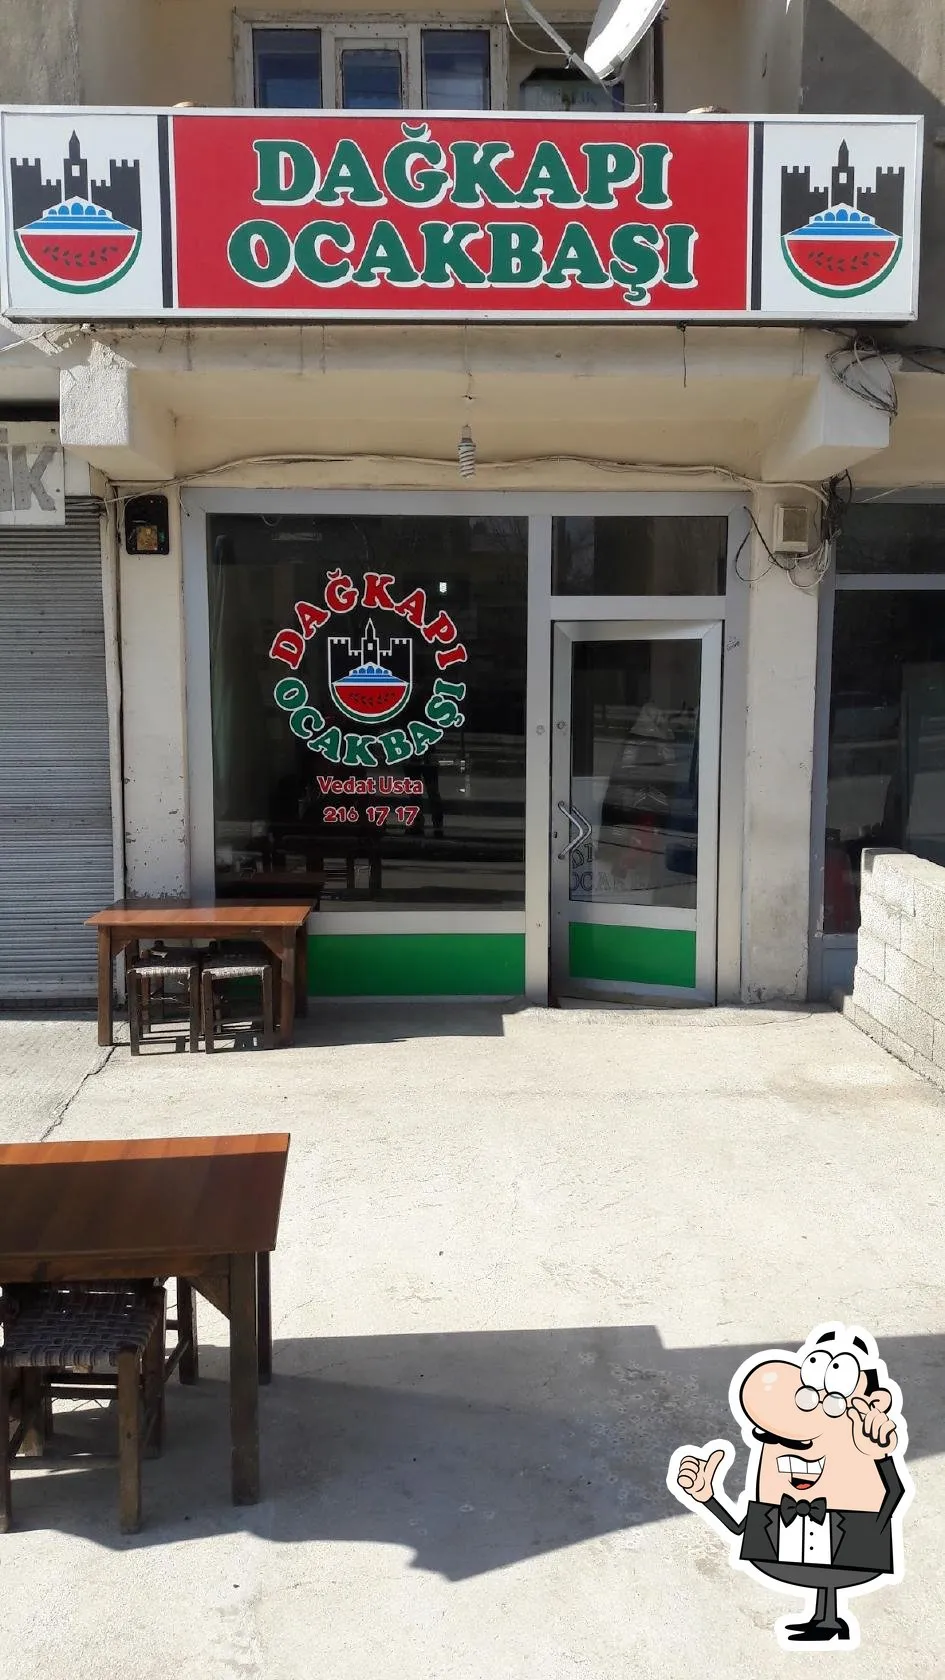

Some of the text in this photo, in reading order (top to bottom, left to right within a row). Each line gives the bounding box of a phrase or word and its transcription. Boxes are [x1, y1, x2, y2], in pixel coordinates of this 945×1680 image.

[253, 122, 673, 209] DAĞKAPI
[227, 219, 699, 306] OCAKBAŞI
[269, 568, 468, 670] DAĞKAPI
[274, 677, 467, 768] OCAKBAŞI
[317, 776, 423, 795] Vedat Usta
[323, 806, 420, 826] 216 17 17
